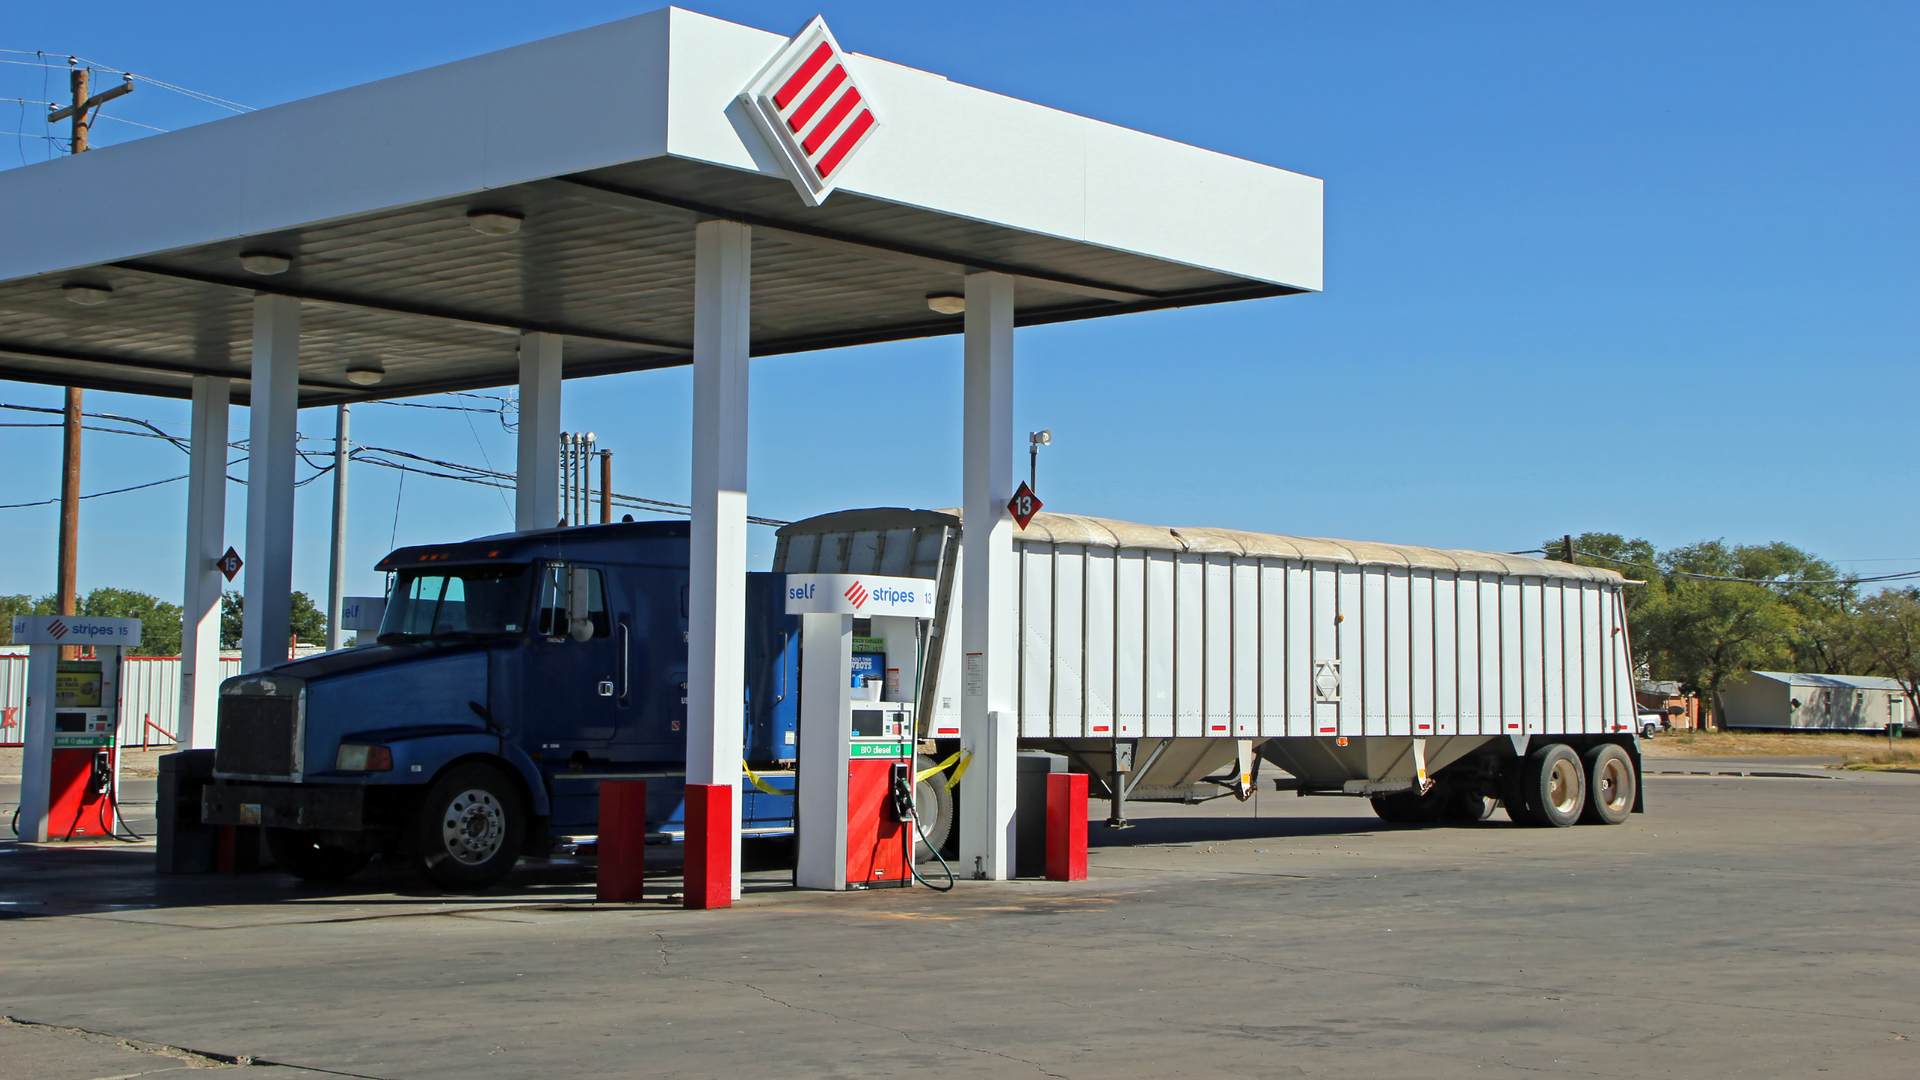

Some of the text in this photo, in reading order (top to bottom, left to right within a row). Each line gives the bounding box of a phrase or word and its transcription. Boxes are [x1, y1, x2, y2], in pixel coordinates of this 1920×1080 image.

[1015, 495, 1032, 516] 13
[224, 557, 237, 572] 15
[789, 583, 815, 599] self
[872, 587, 932, 606] stripes 13
[72, 623, 128, 638] stripes 15
[851, 661, 873, 670] WBOYS
[860, 745, 892, 755] BIO diesel
